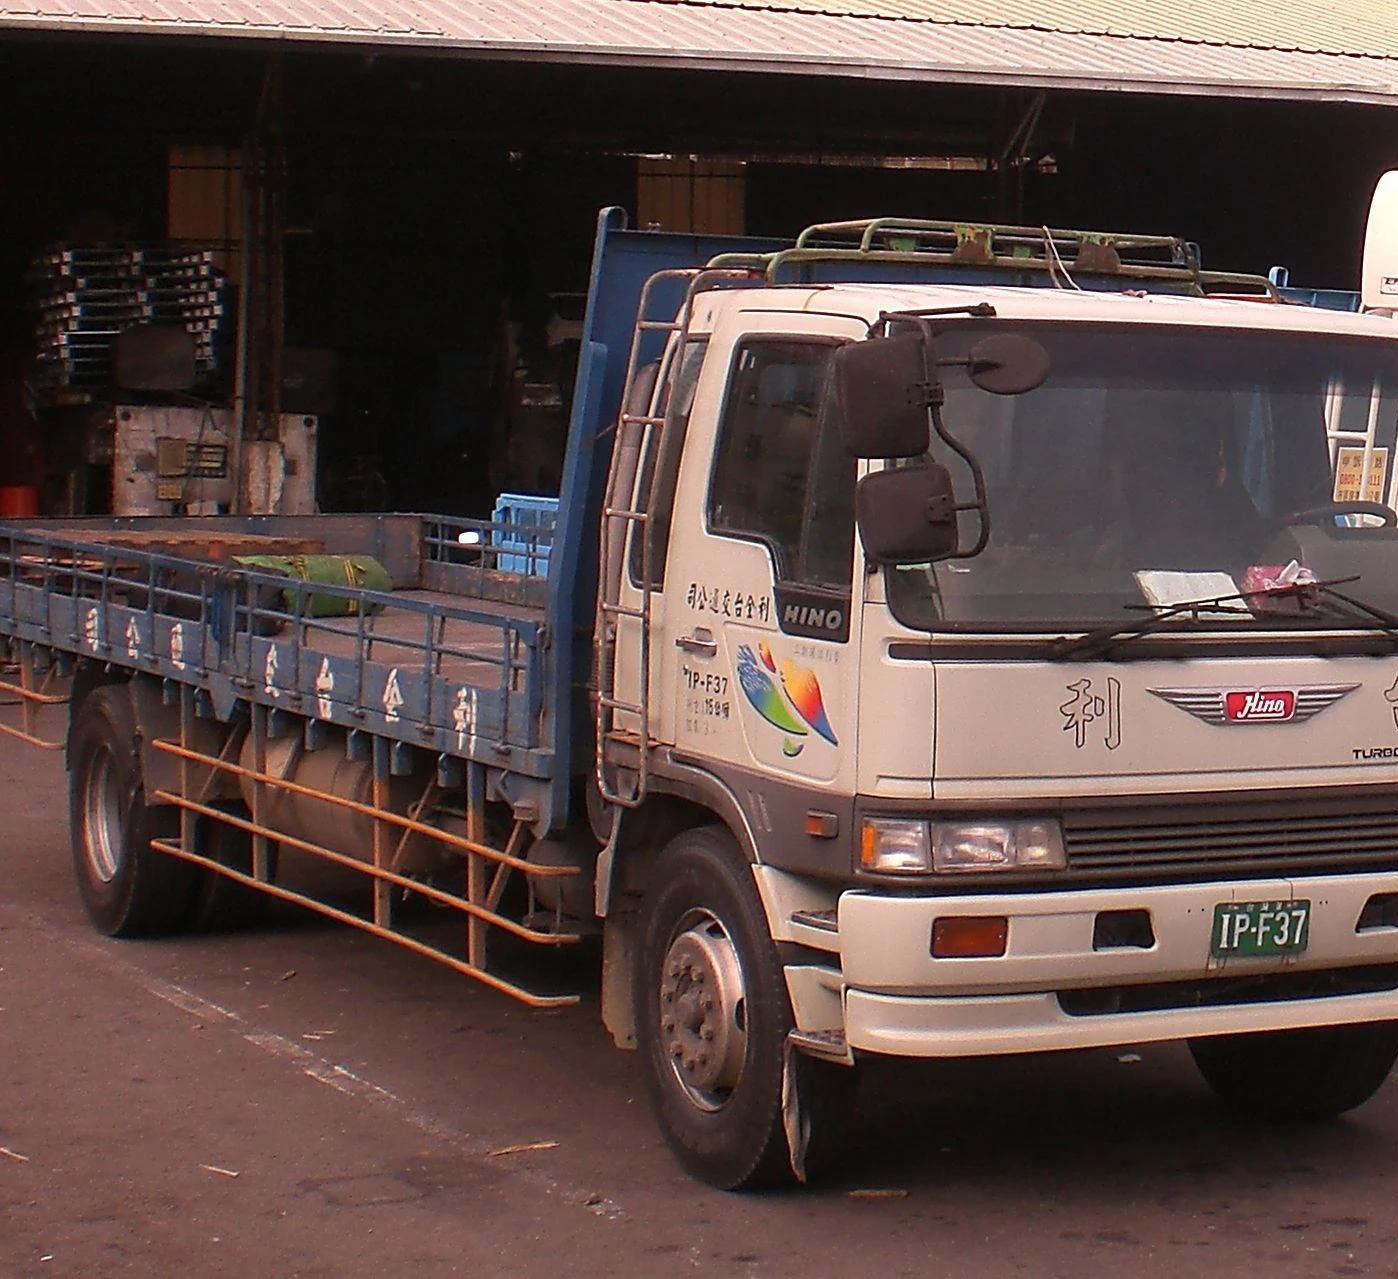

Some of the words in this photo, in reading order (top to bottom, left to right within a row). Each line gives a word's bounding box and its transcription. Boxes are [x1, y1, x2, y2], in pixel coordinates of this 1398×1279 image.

[784, 605, 842, 630] HINO
[688, 671, 728, 695] IP-F37
[1059, 677, 1121, 750] 利
[1236, 692, 1286, 718] Hino
[1219, 909, 1307, 949] IP-F37
